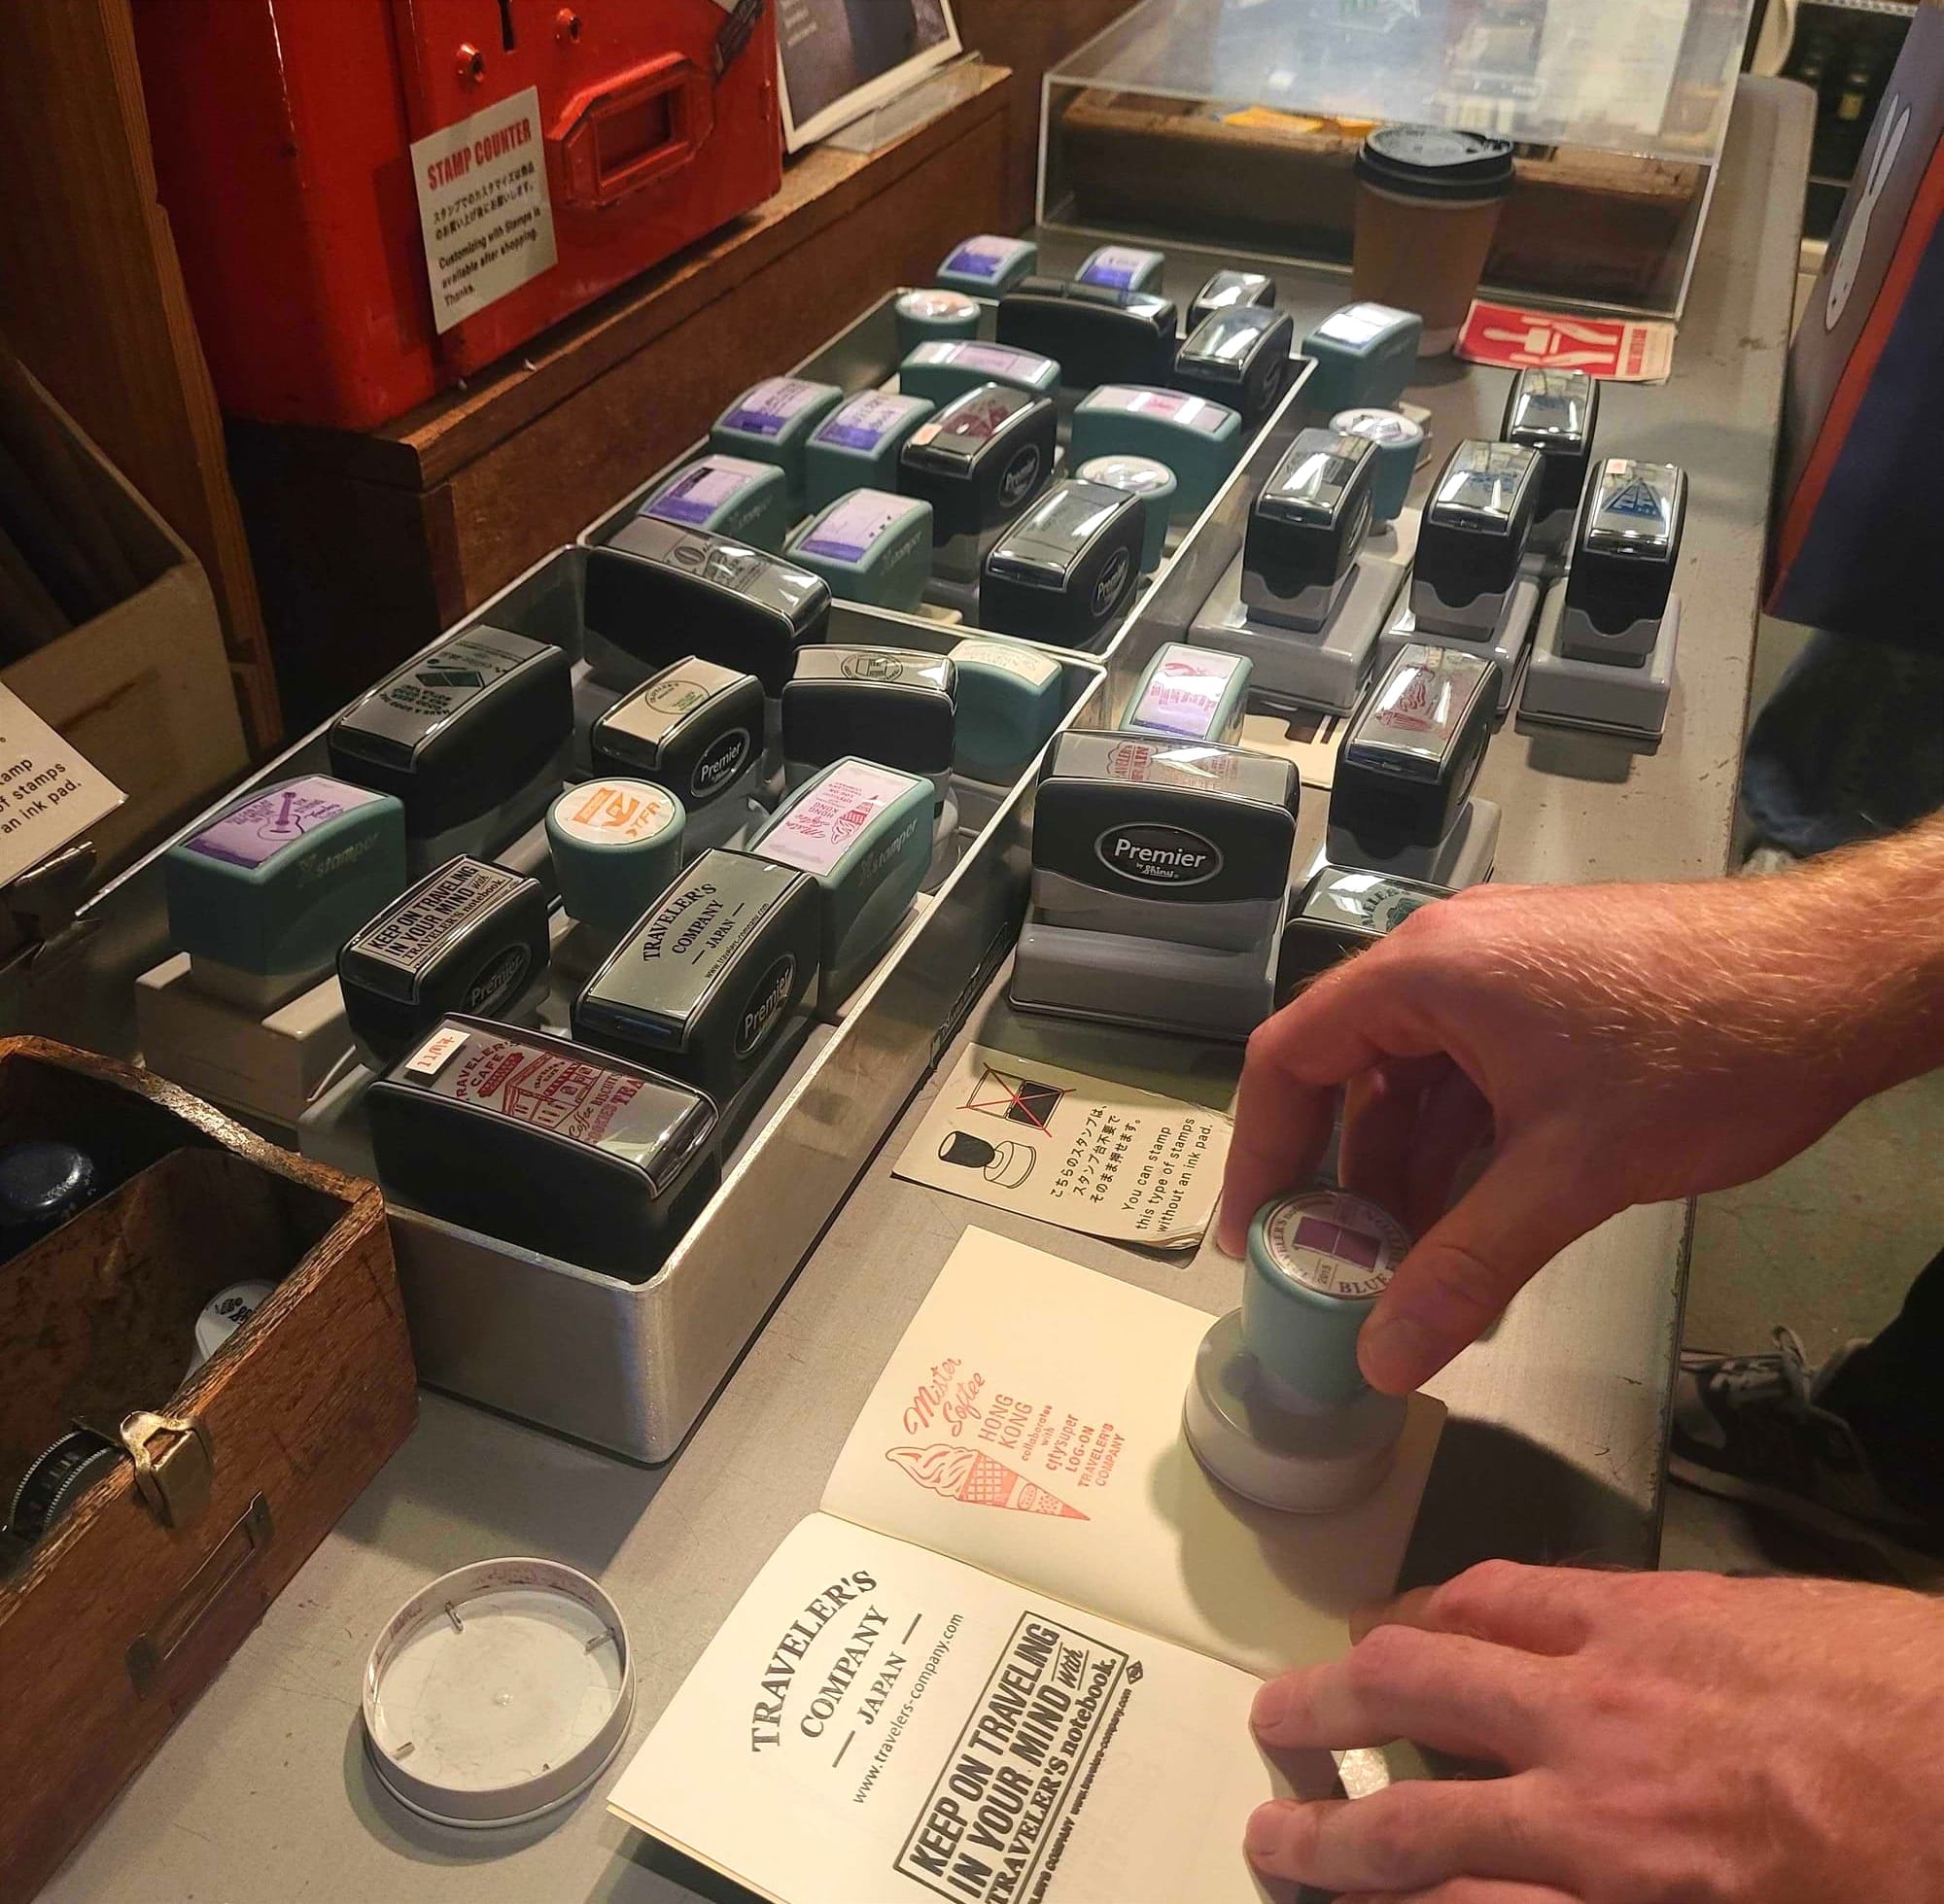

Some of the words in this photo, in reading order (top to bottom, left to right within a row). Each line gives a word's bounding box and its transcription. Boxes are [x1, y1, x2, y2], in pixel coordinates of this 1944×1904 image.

[428, 147, 471, 190] STAMP
[474, 118, 532, 166] COUNTER
[438, 239, 487, 270] Customizing
[488, 224, 503, 245] with
[442, 262, 478, 290] available
[479, 251, 499, 269] after
[13, 763, 66, 801] stamps
[701, 742, 743, 782] Premier
[3, 816, 22, 835] an
[21, 800, 48, 820] ink
[48, 779, 82, 805] pad.
[1114, 839, 1207, 868] Premier
[1142, 864, 1175, 879] Shiny
[367, 925, 400, 951] KEEP
[398, 910, 414, 927] ON
[412, 865, 479, 914] TRAVELING
[385, 940, 405, 957] IN
[401, 914, 436, 943] YOUR
[434, 886, 475, 916] MIND
[401, 911, 465, 960] TRAVELER'S
[463, 879, 506, 913] notebook.
[642, 883, 717, 962] TRAVELER'S
[672, 899, 724, 954] COMPANY
[707, 918, 736, 950] JAPAN
[470, 947, 524, 1007] Premier
[745, 965, 794, 1039] Premier
[470, 1053, 507, 1088] CAFE
[569, 1107, 594, 1138] Coffee
[1051, 1105, 1107, 1199] こちらのスタンプは、
[1073, 1115, 1121, 1196] スタンプ台不要で
[1091, 1118, 1142, 1204] そのまま押せます。
[1122, 1189, 1140, 1212] You
[1135, 1165, 1153, 1188] can
[1149, 1125, 1172, 1165] stamp
[1135, 1206, 1155, 1229] this
[1147, 1176, 1170, 1205] type
[1163, 1160, 1175, 1178] of
[1170, 1117, 1197, 1159] stamps
[1157, 1191, 1182, 1233] without
[1178, 1171, 1191, 1189] an
[1186, 1151, 1199, 1172] ink
[1196, 1123, 1214, 1150] pad.
[903, 1357, 962, 1436] Mister
[943, 1371, 986, 1437] Softee
[978, 1393, 1014, 1443] HONG
[997, 1402, 1034, 1450] KONG
[1022, 1404, 1053, 1462] collaborates
[1041, 1426, 1056, 1446] with
[1077, 1422, 1115, 1488] TRAVELER'S
[1094, 1434, 1127, 1487] COMPANY
[750, 1569, 878, 1753] TRAVELER'S
[799, 1604, 889, 1740] COMPANY
[857, 1652, 909, 1727] JAPAN
[968, 1622, 1060, 1761] TRAVELING
[1056, 1644, 1086, 1691] with
[852, 1612, 964, 1805] www.travelers-company.com
[1008, 1683, 1072, 1769] MIND
[948, 1755, 994, 1803] ON
[967, 1763, 1035, 1852] YOUR
[985, 1757, 1069, 1904] TRAVELER'S
[1062, 1658, 1117, 1760] notebook.
[909, 1801, 969, 1878] KEEP
[1049, 1816, 1076, 1873] COMPANY
[946, 1851, 993, 1899] IN
